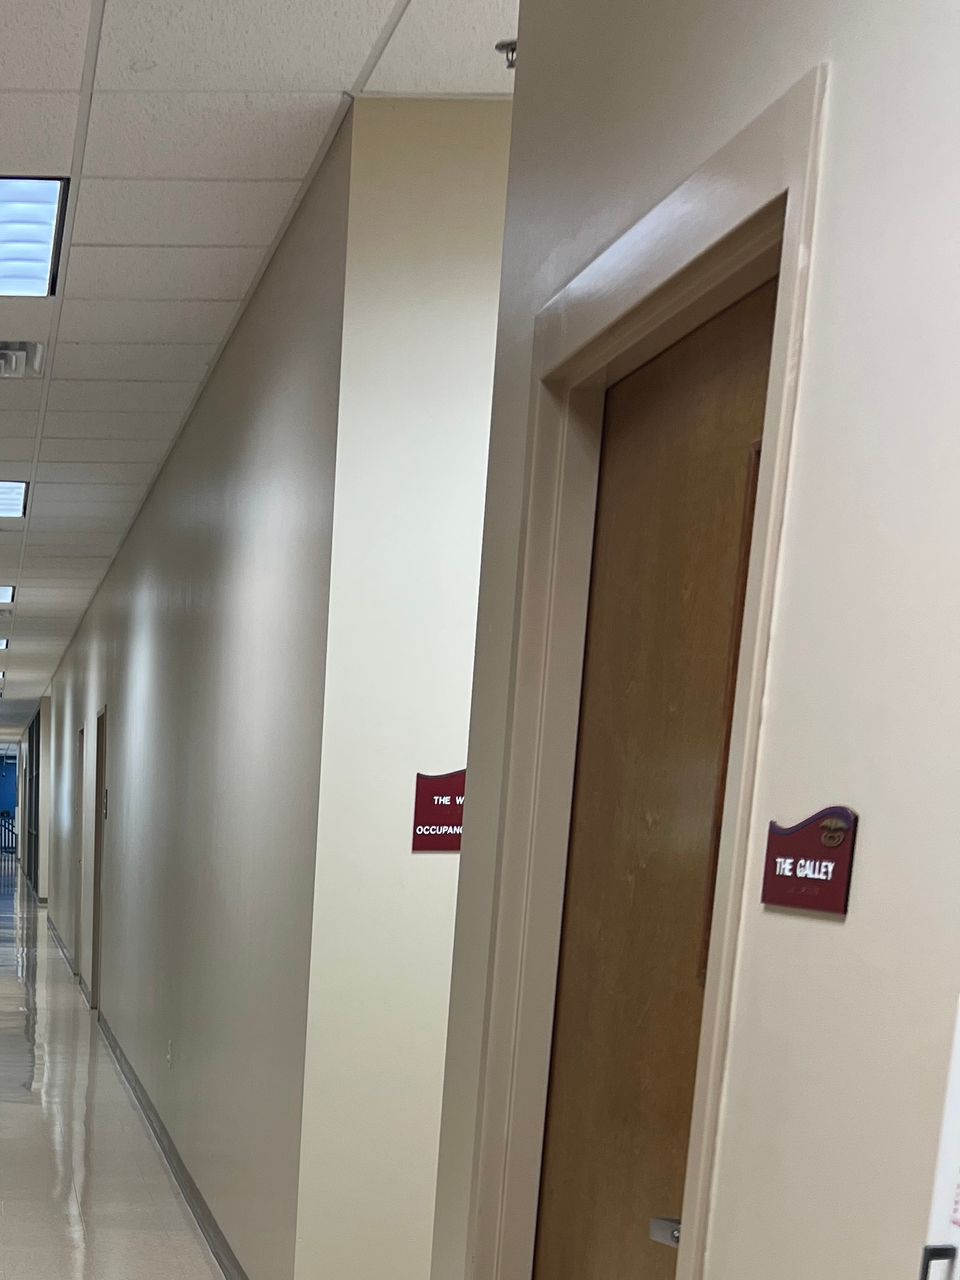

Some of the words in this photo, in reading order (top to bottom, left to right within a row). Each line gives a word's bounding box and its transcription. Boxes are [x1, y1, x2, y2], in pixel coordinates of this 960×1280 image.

[433, 796, 451, 805] THE
[455, 796, 465, 805] W
[416, 825, 463, 835] OCCUPAN
[775, 857, 794, 876] THE
[796, 858, 835, 880] GALLEY
